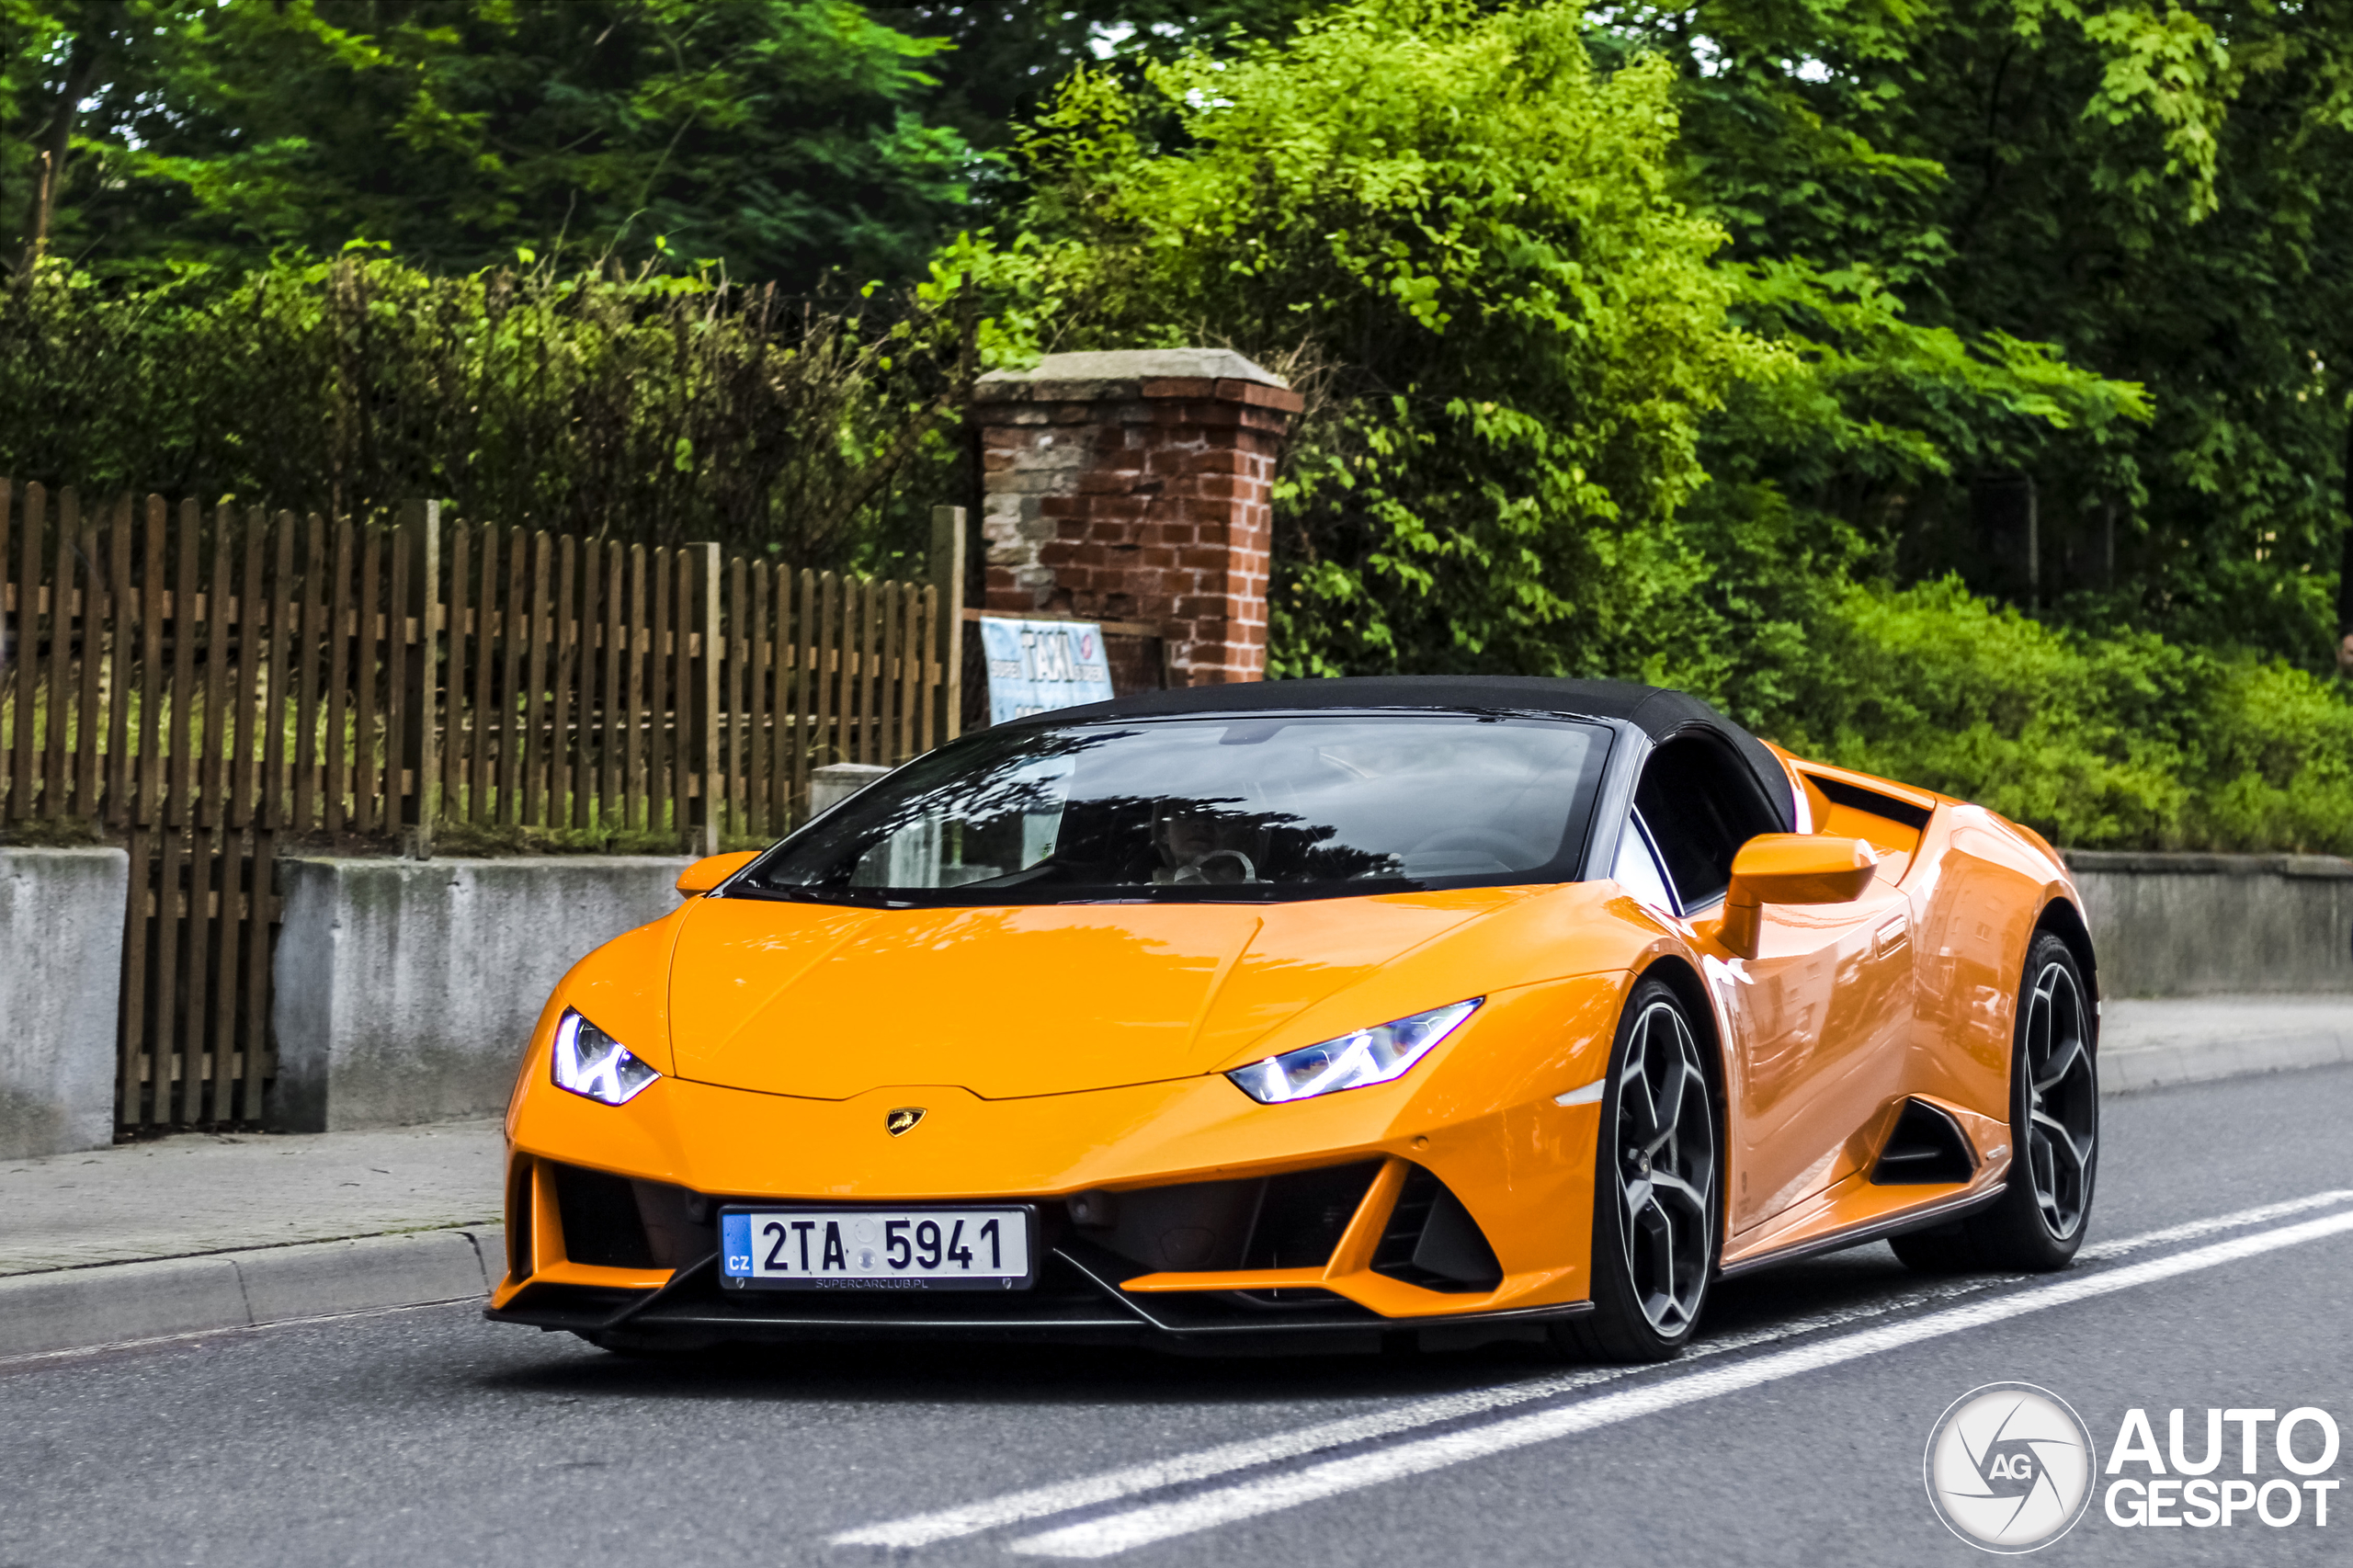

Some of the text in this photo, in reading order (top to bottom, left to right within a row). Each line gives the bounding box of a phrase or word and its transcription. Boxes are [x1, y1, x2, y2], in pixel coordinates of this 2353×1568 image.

[1020, 629, 1074, 682] TAXI
[763, 1219, 1002, 1271] 2TA 5941
[729, 1255, 750, 1271] CZ
[815, 1278, 929, 1290] SUPERCARCLUB.PL
